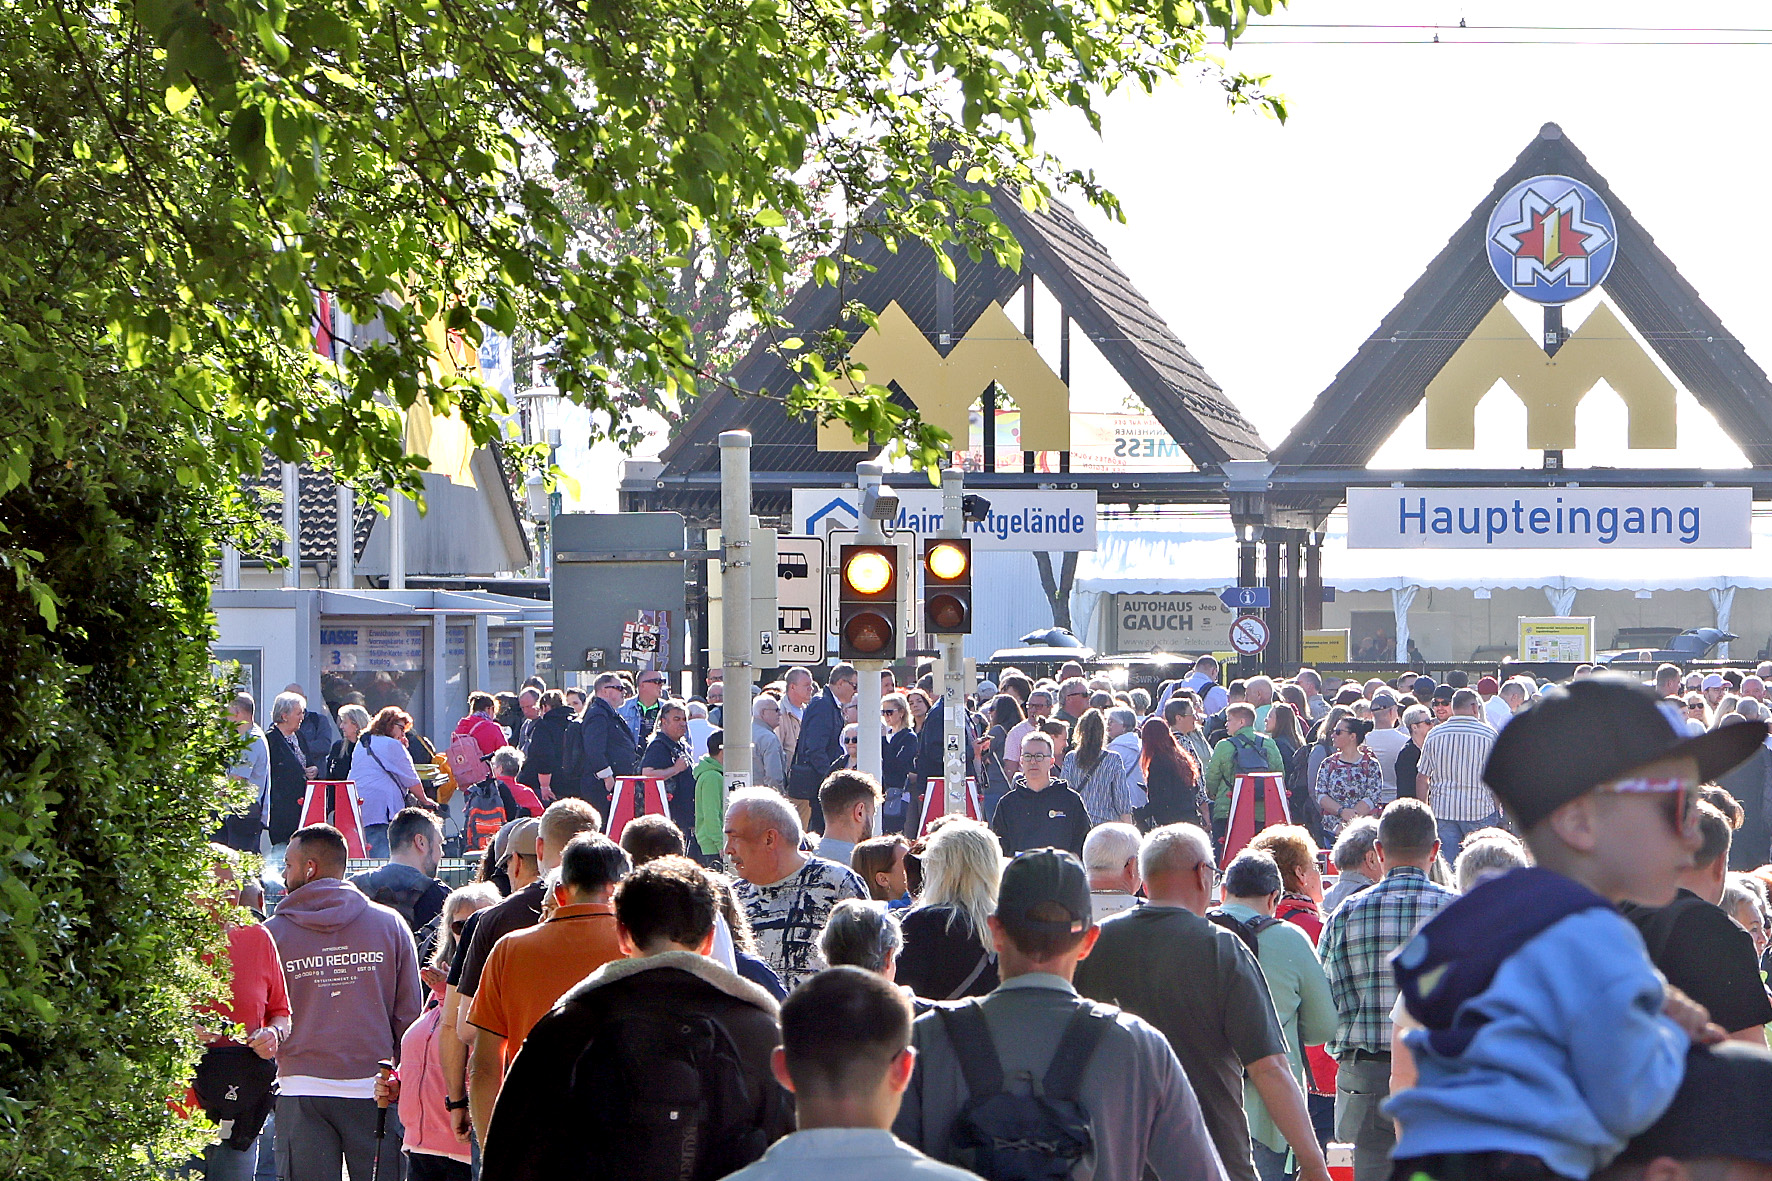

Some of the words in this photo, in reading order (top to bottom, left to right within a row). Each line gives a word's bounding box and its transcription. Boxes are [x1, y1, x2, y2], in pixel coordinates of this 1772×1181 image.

[889, 507, 1084, 540] Maimktgelände
[1400, 497, 1700, 544] Haupteingang
[1123, 601, 1193, 612] AUTOHAUS
[1198, 604, 1217, 612] Jeep
[1123, 614, 1193, 631] GAUCH
[320, 630, 358, 645] KASSE
[1184, 638, 1210, 646] Telefon
[331, 650, 341, 665] 3
[778, 644, 815, 656] rrang
[286, 955, 324, 973] STWD
[326, 951, 384, 967] RECORDS
